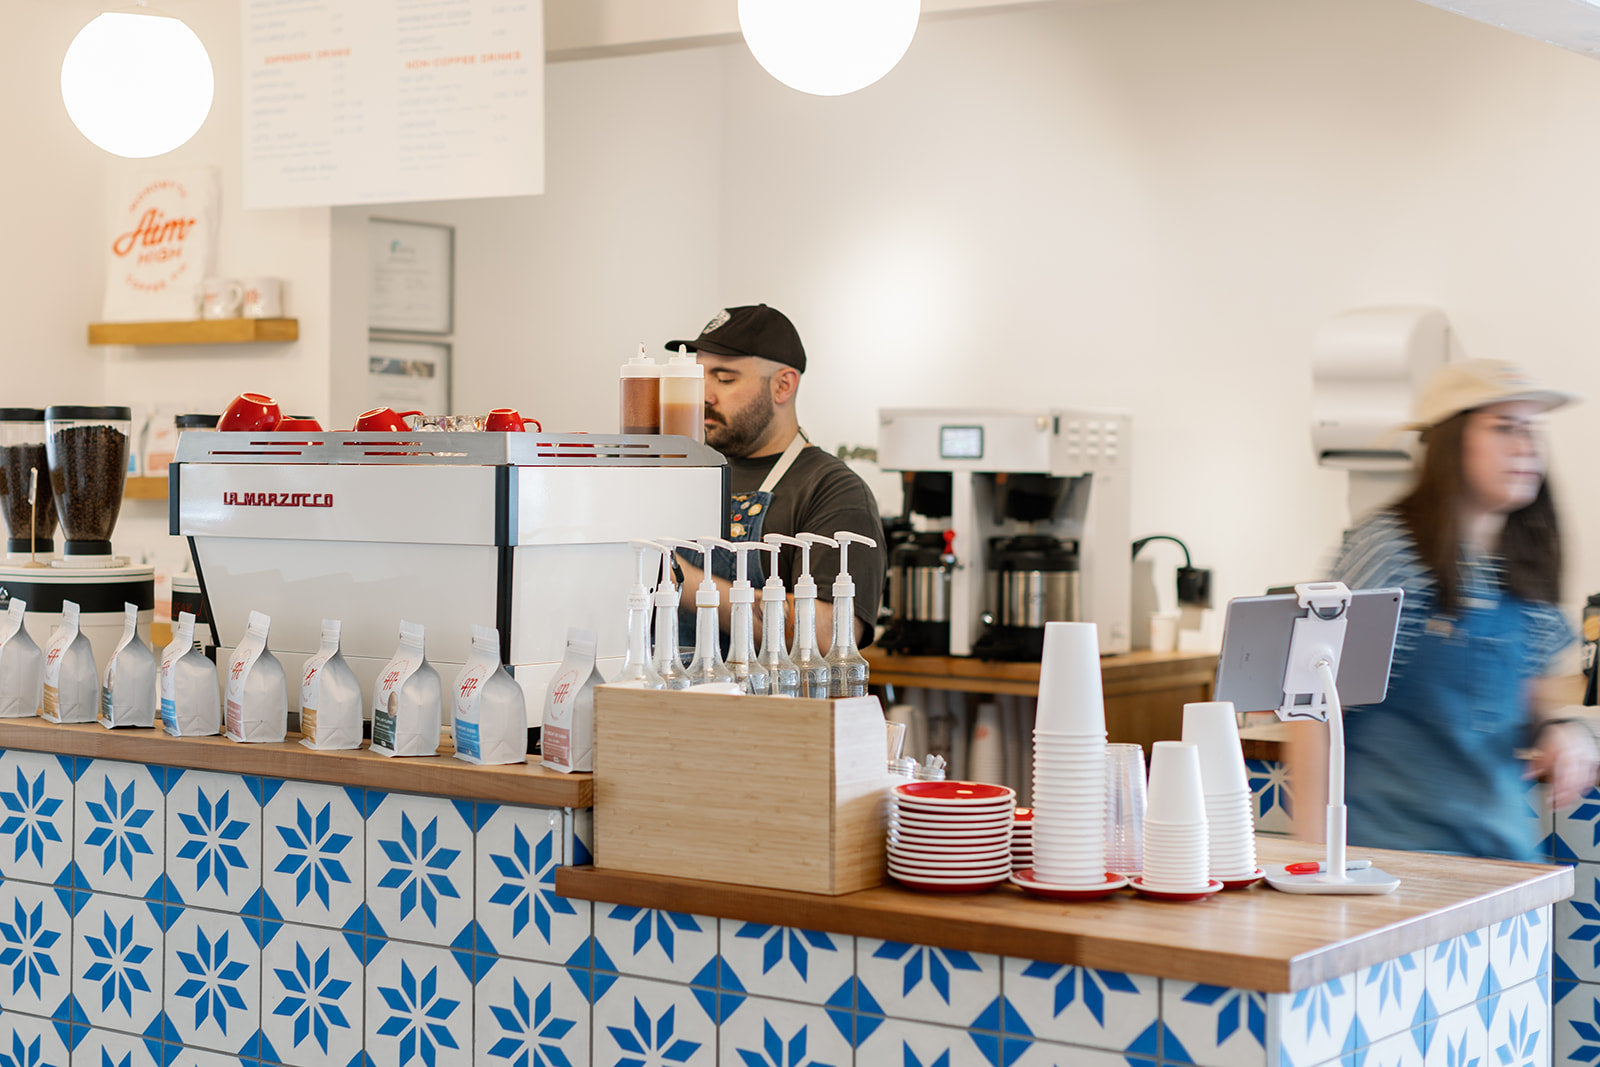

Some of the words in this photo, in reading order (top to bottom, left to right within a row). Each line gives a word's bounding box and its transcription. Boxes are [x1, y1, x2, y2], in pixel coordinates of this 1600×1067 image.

[112, 206, 197, 257] Aim
[223, 491, 238, 506] LA
[244, 492, 334, 507] MARZOCCO
